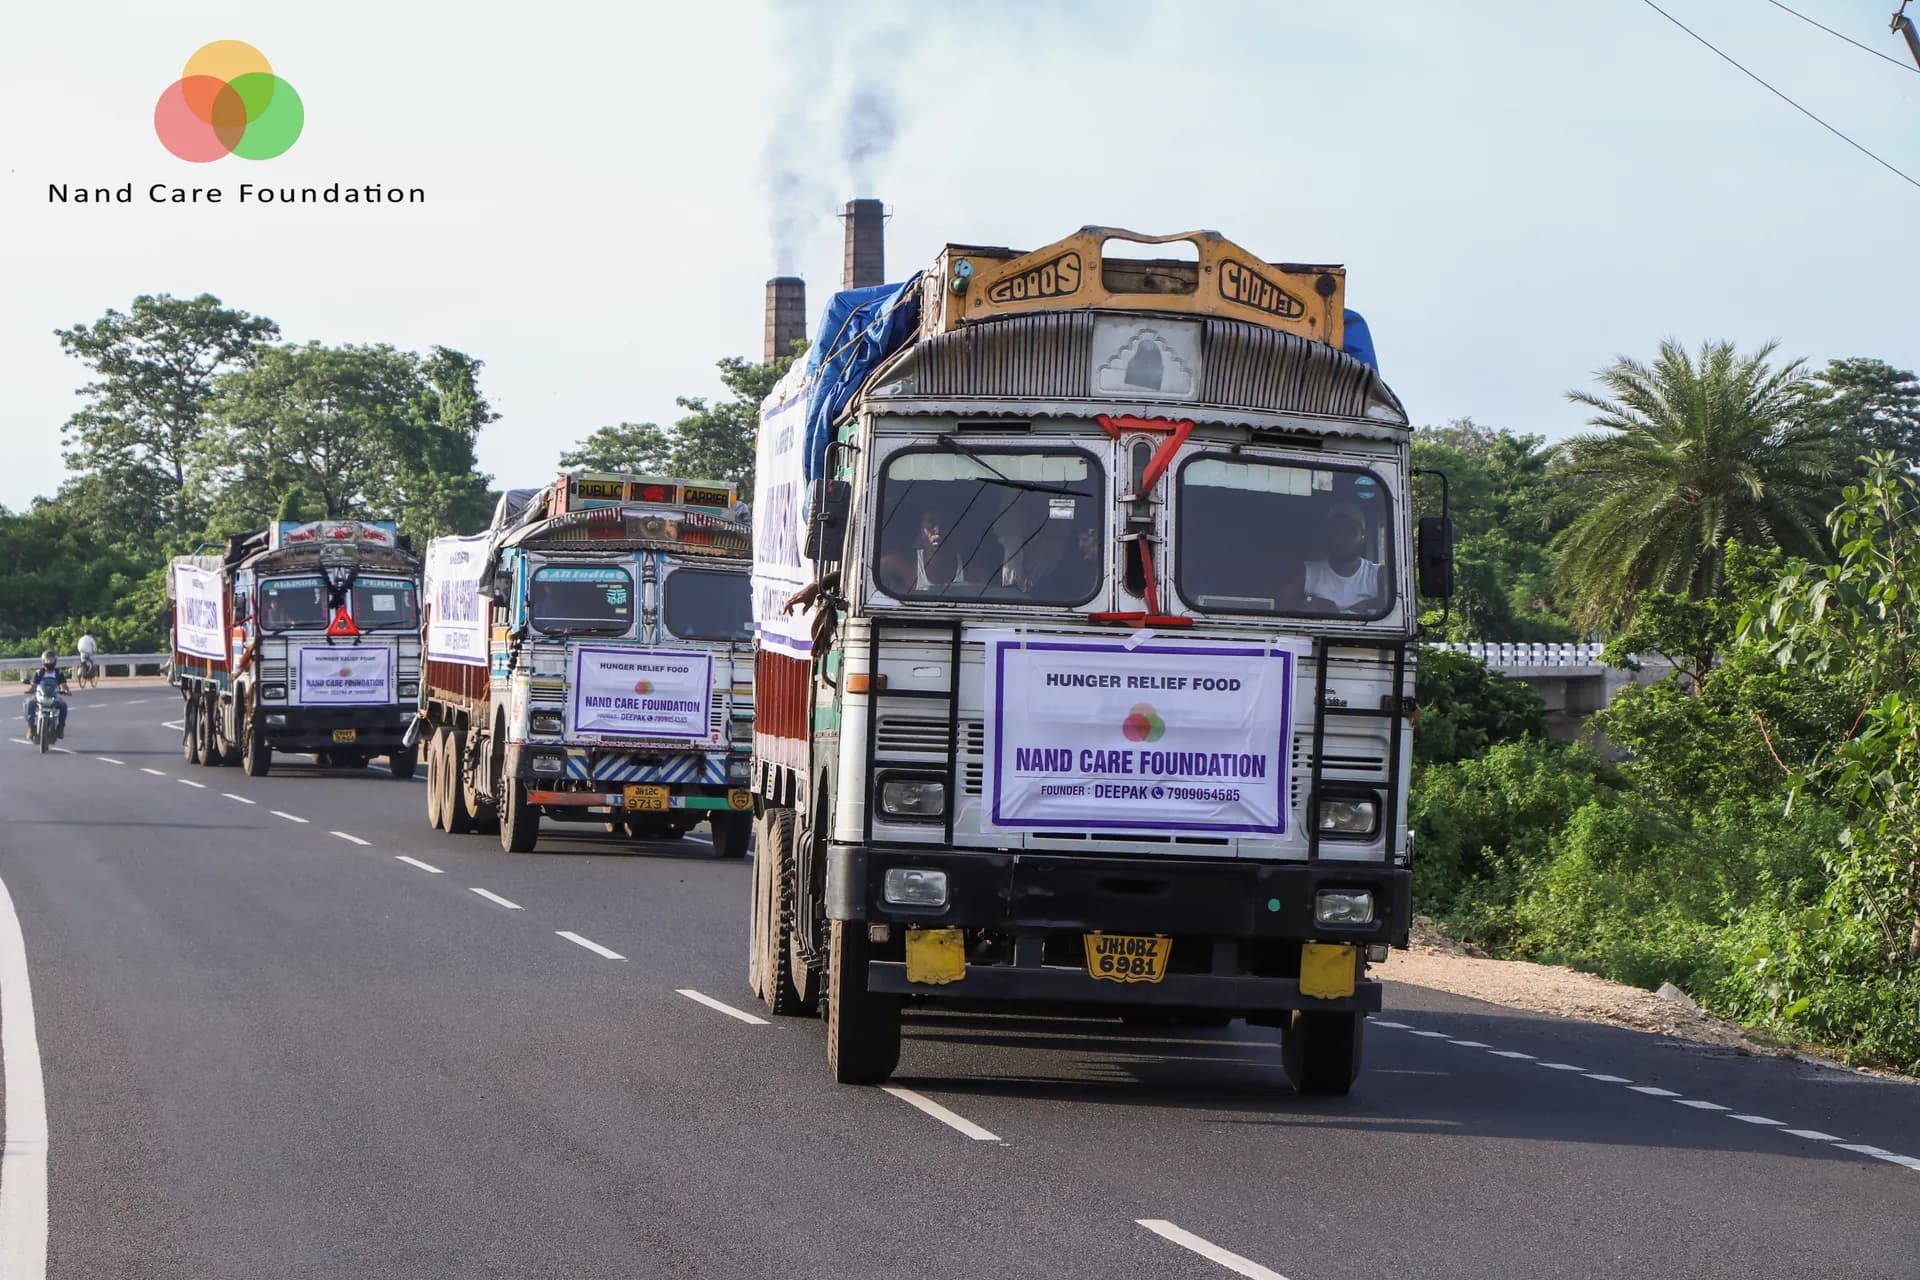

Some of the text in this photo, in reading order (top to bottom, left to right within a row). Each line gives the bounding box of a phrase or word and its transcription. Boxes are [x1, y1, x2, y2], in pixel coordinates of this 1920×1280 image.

[579, 484, 728, 504] PUBLIC CARRIER
[600, 663, 635, 671] HUNGER
[1046, 673, 1241, 692] HUNGER RELIEF FOOD
[585, 696, 700, 713] NAND CARE FOUNDATION
[1016, 747, 1266, 778] NAND CARE FOUNDATION
[1095, 784, 1148, 800] DEEPAK
[1167, 787, 1240, 802] 7909054585
[628, 798, 662, 809] 9713
[1099, 955, 1156, 975] 6981
